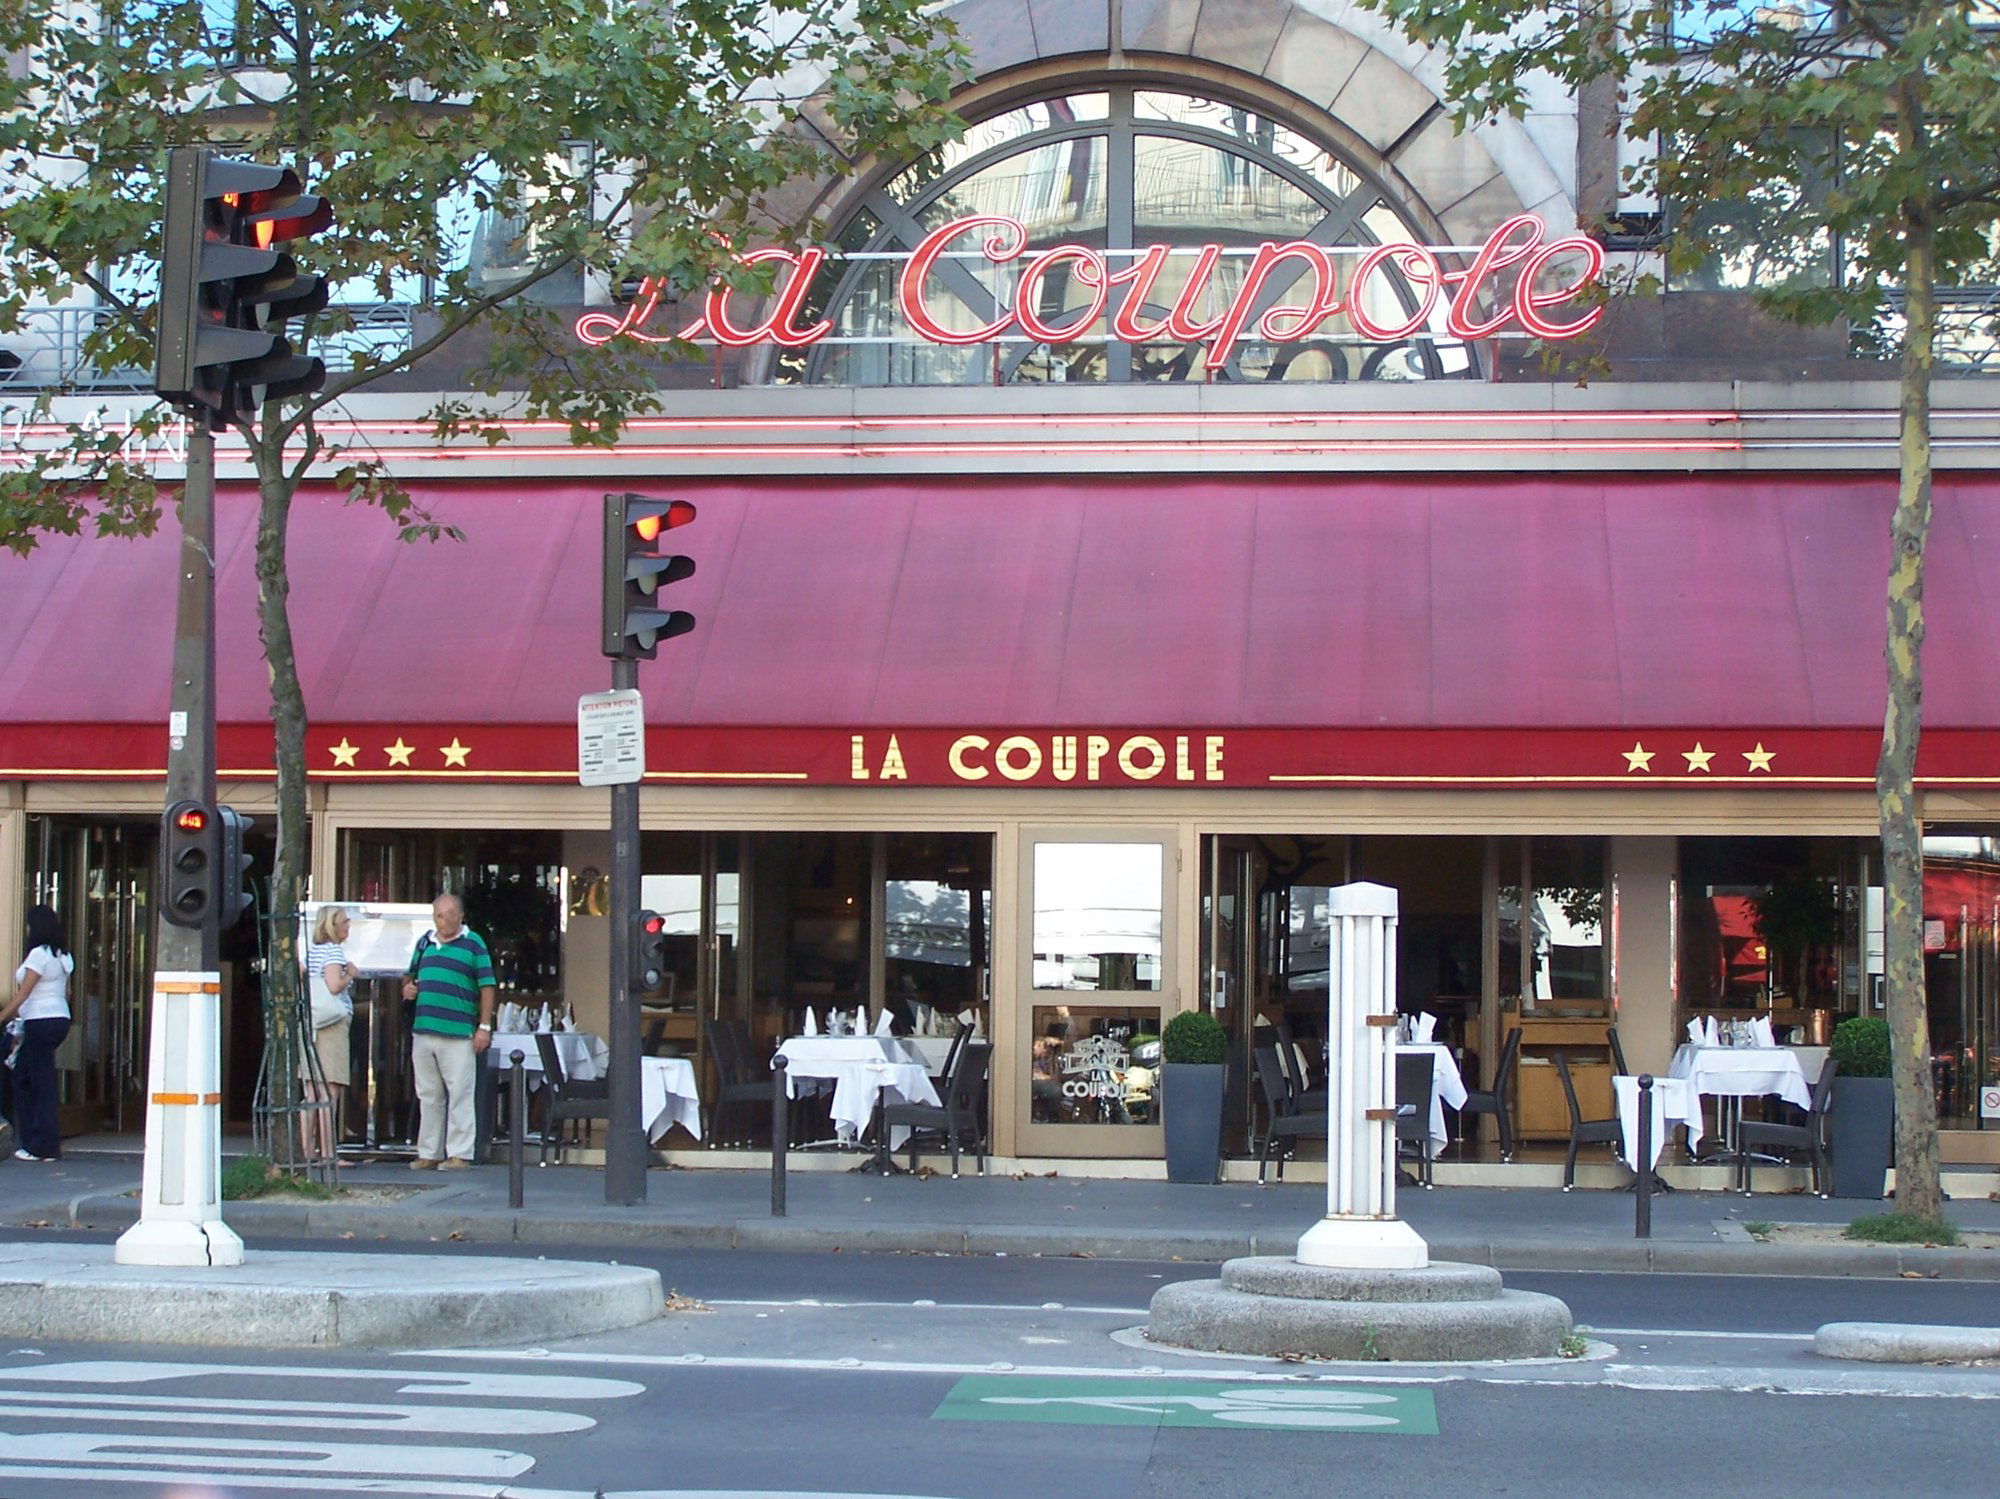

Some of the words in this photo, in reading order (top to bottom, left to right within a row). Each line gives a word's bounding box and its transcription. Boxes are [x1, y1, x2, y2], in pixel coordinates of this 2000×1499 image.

[900, 213, 1605, 372] Coupole
[851, 734, 907, 780] LA
[948, 735, 1225, 782] COUPOLE
